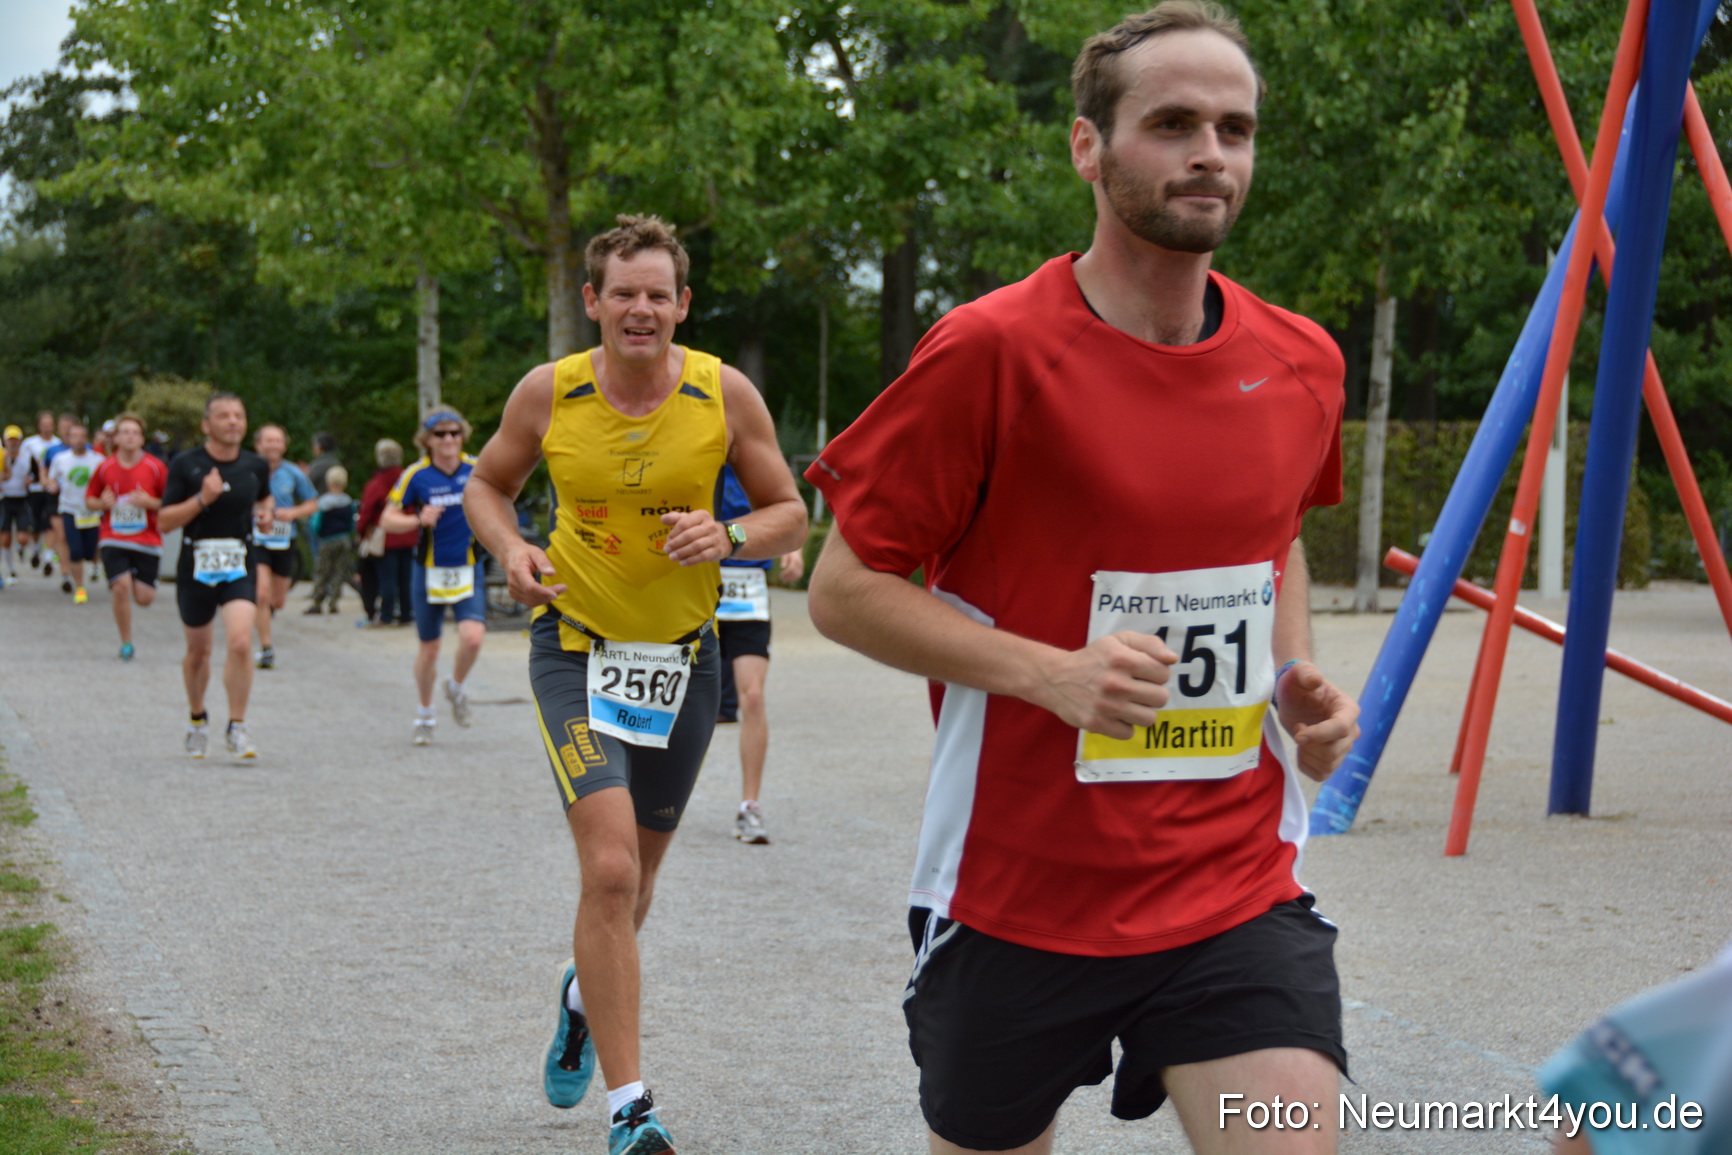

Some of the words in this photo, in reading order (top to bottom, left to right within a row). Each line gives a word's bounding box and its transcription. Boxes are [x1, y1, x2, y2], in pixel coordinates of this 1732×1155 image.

[577, 505, 608, 518] Seidl
[1098, 593, 1170, 614] PARTL
[1175, 588, 1258, 612] Neumarkt
[633, 652, 679, 664] Neumarkt
[600, 666, 683, 706] 2560
[616, 708, 653, 730] Robert
[571, 722, 602, 761] Run!
[1145, 719, 1235, 749] Martin
